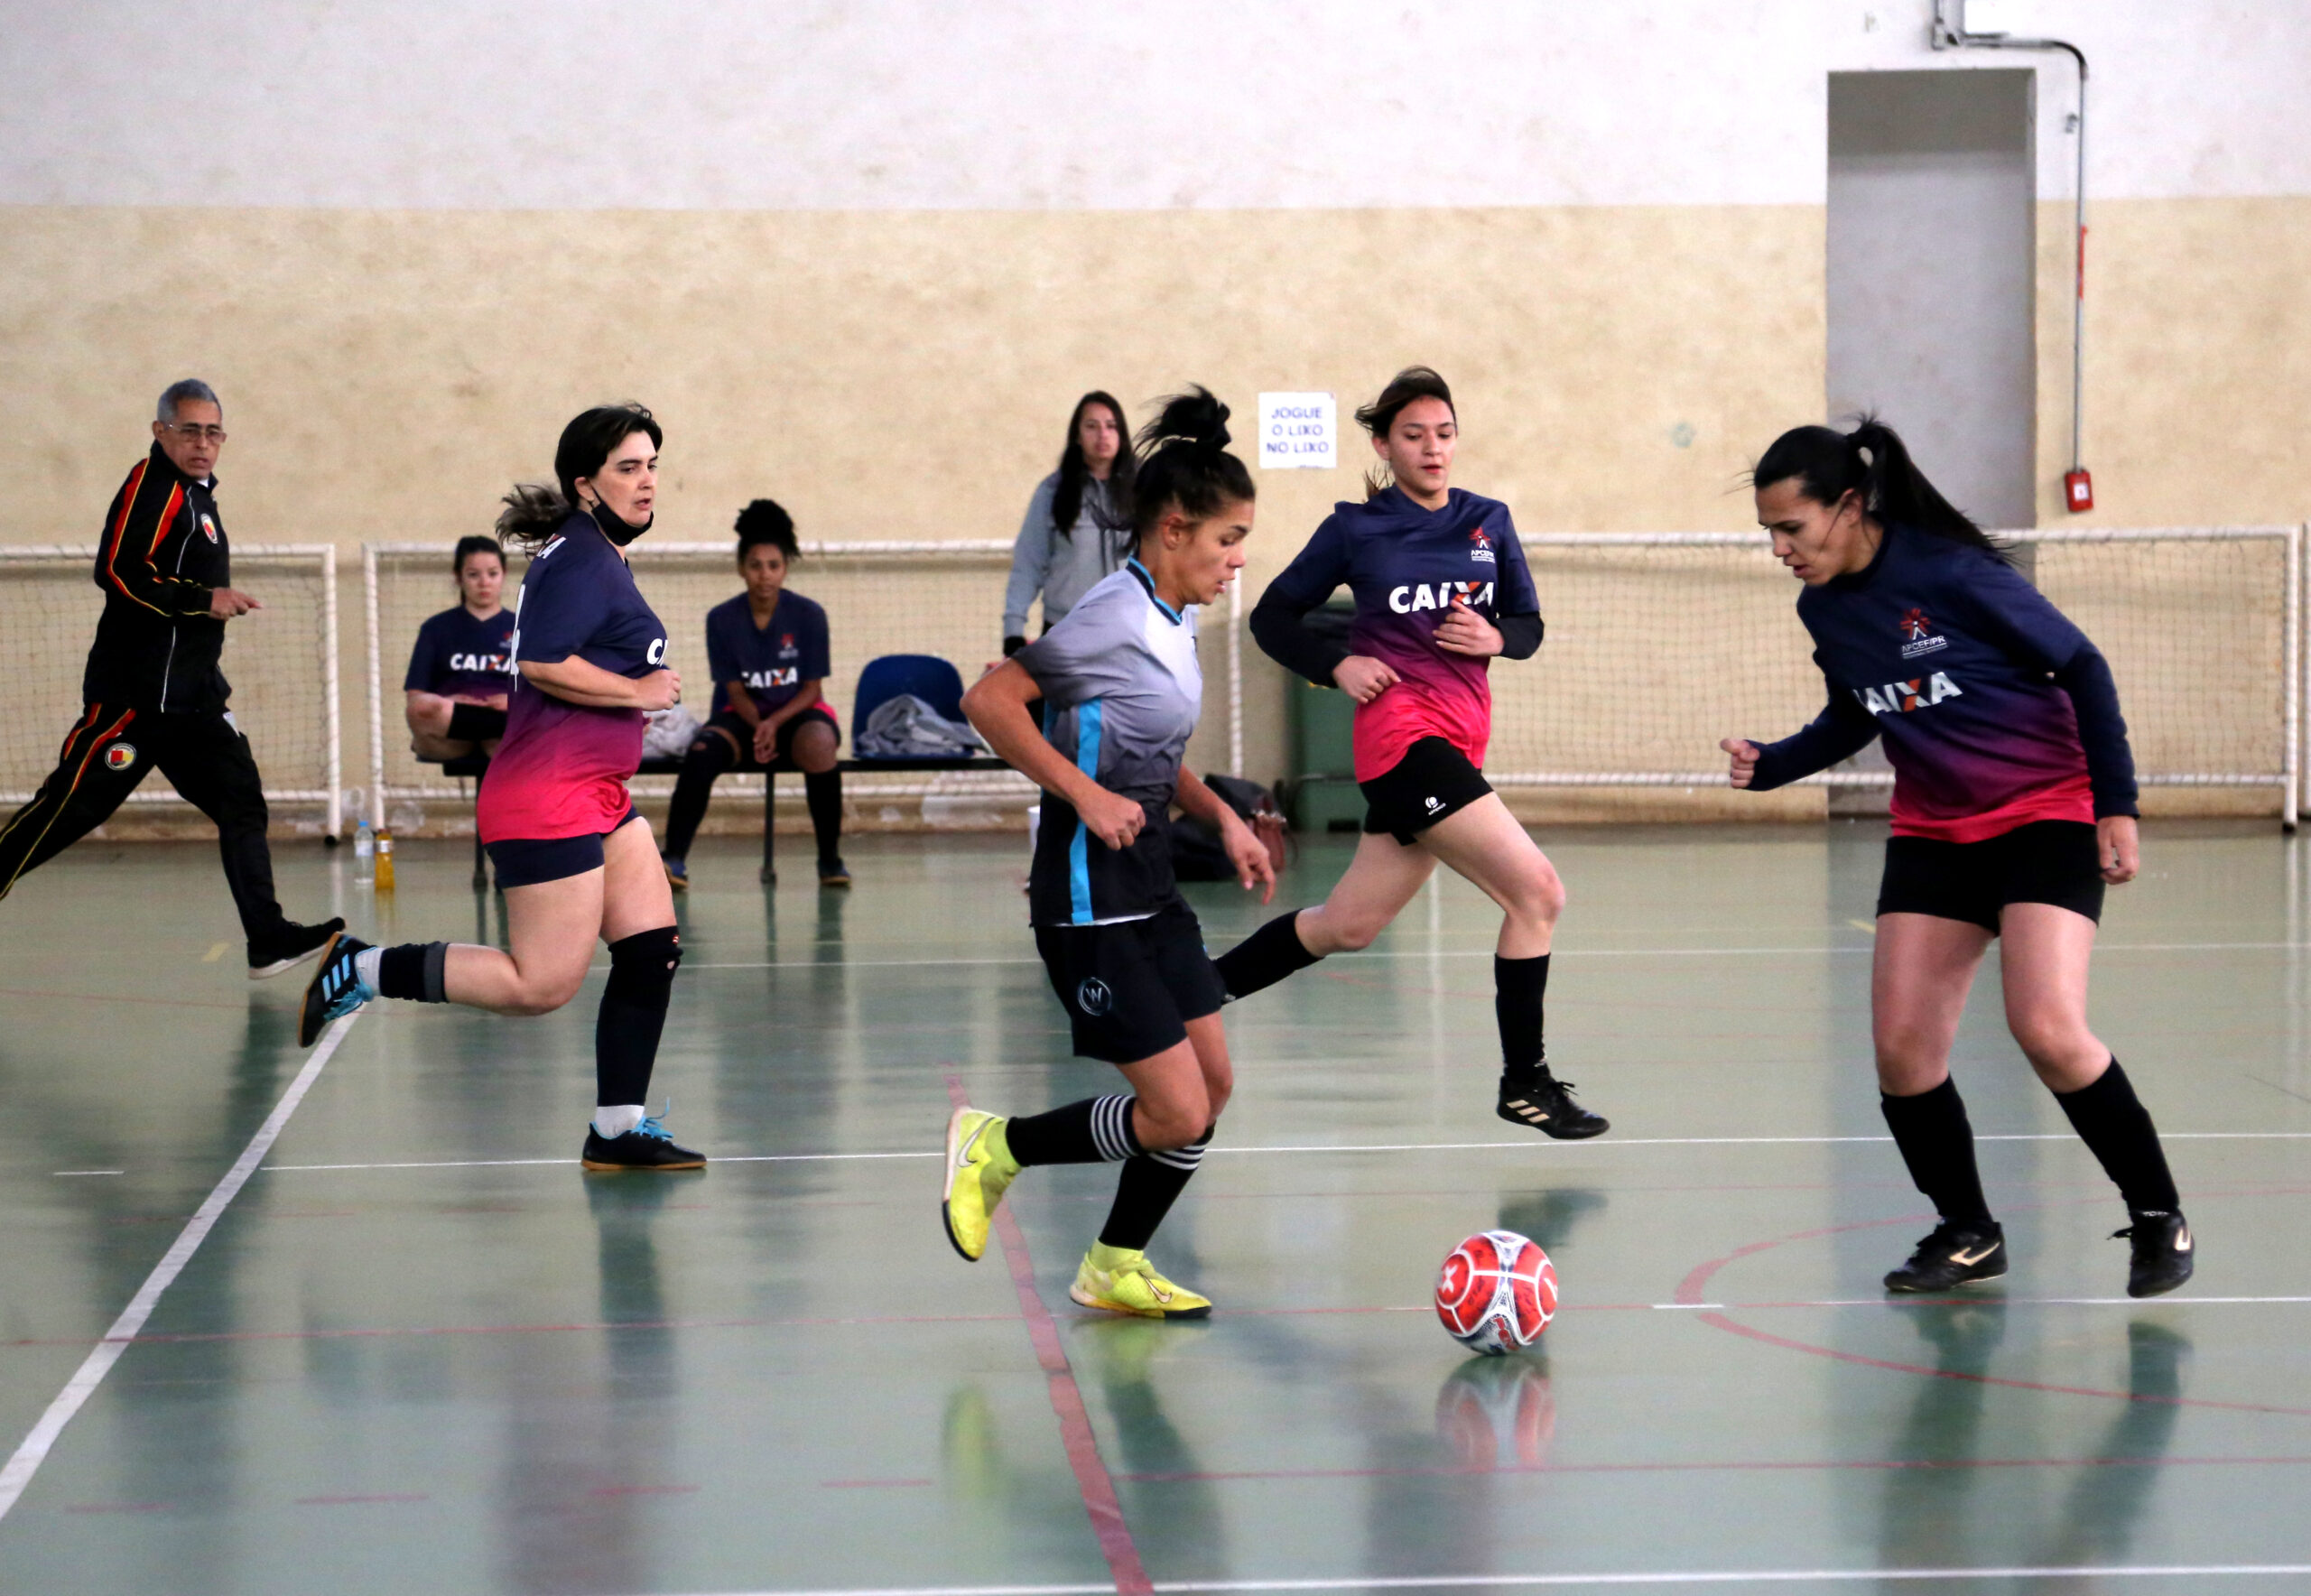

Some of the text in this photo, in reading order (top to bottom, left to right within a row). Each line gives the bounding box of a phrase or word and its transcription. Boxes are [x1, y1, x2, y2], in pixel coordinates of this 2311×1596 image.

[1271, 406, 1323, 420] JOGUE
[1271, 423, 1323, 437] O LIXO
[1266, 441, 1329, 454] NO LIXO
[1388, 581, 1494, 614] CAIXA
[1852, 672, 1963, 716] AIXA
